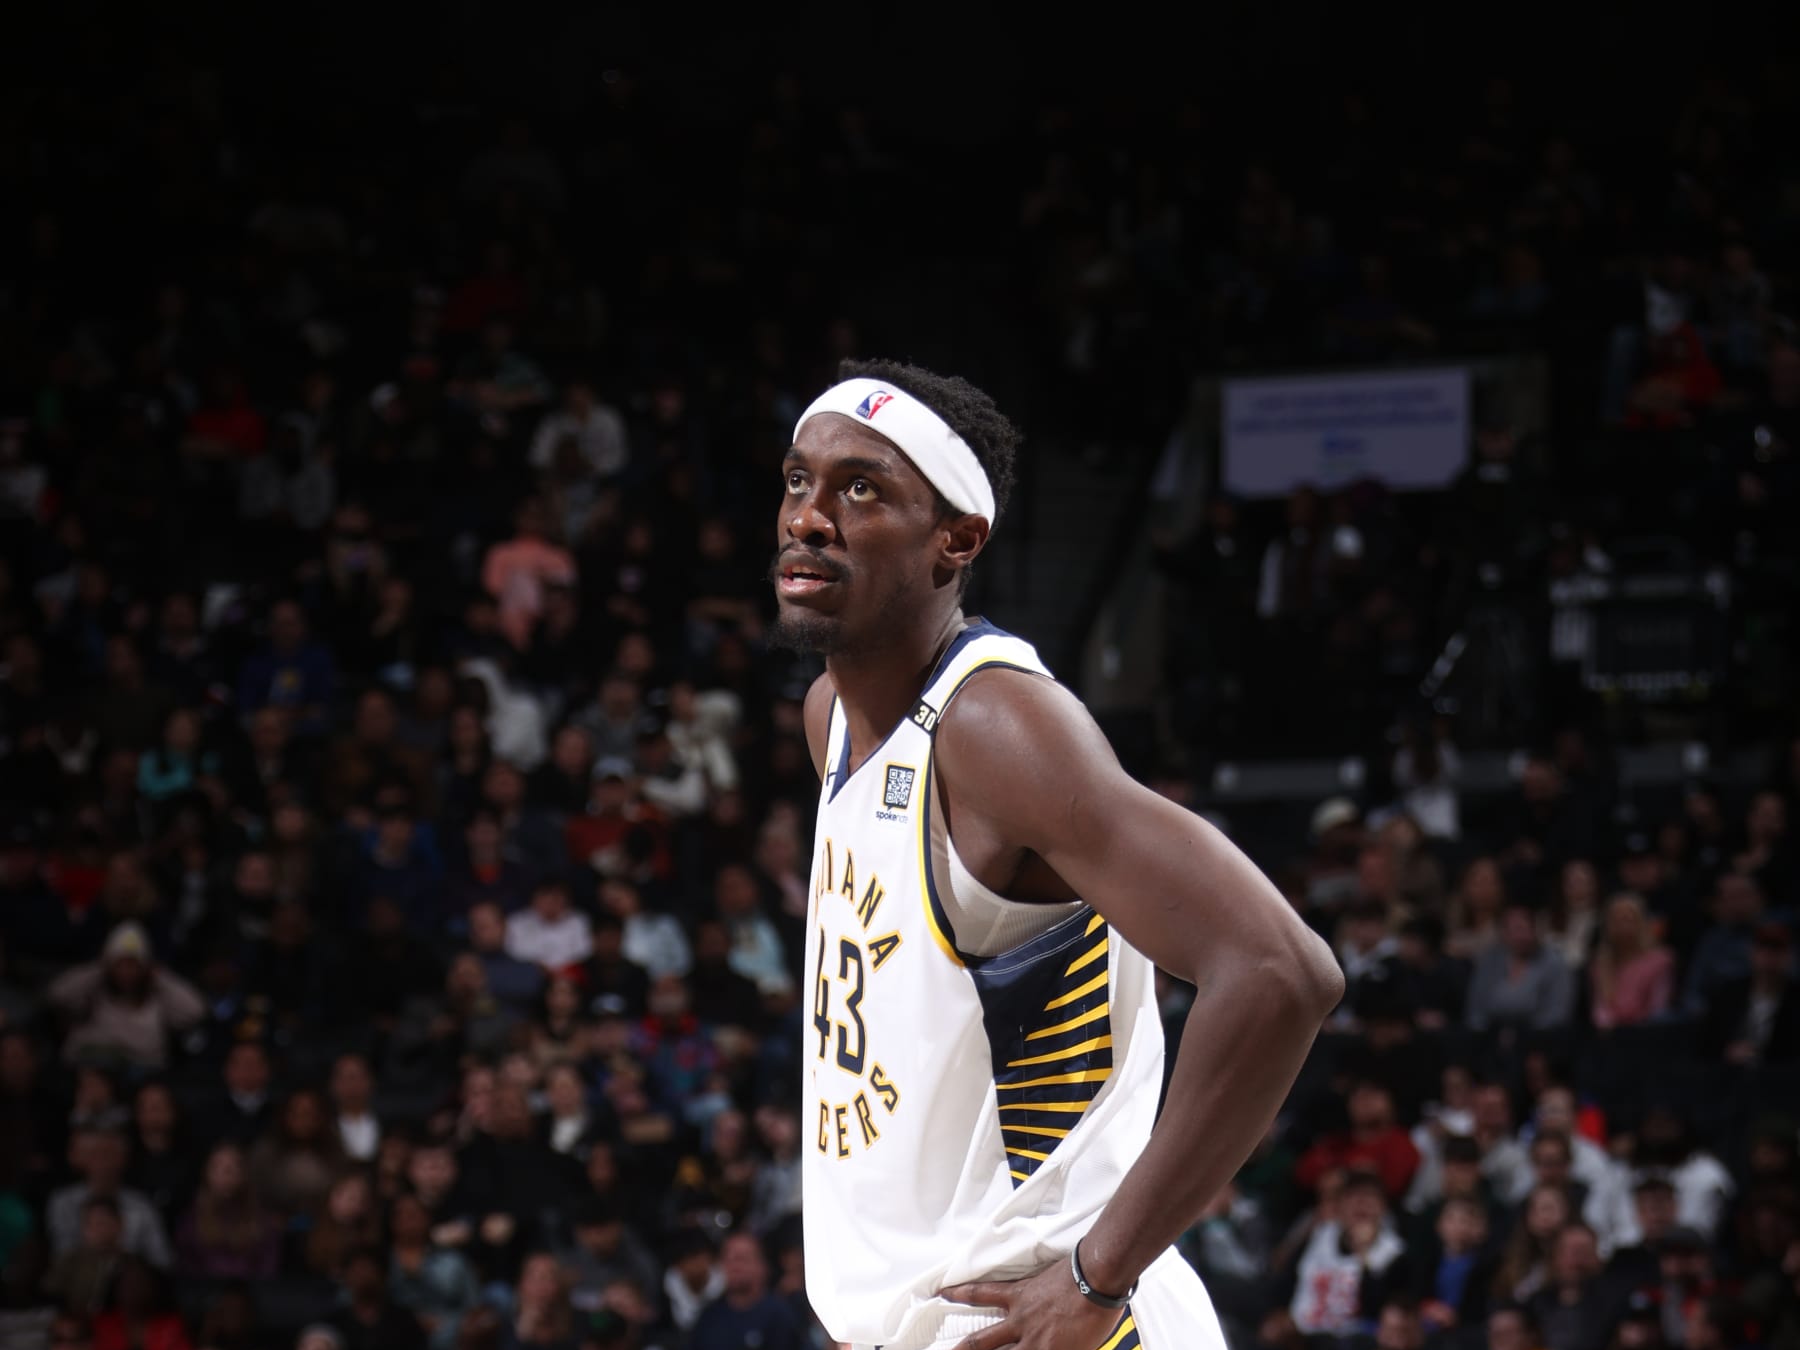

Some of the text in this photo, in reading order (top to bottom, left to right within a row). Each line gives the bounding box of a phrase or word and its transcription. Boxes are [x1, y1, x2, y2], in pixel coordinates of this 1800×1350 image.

[914, 705, 936, 731] 30
[814, 837, 903, 973] IANA
[814, 922, 866, 1077] 43
[818, 1061, 900, 1160] CERS
